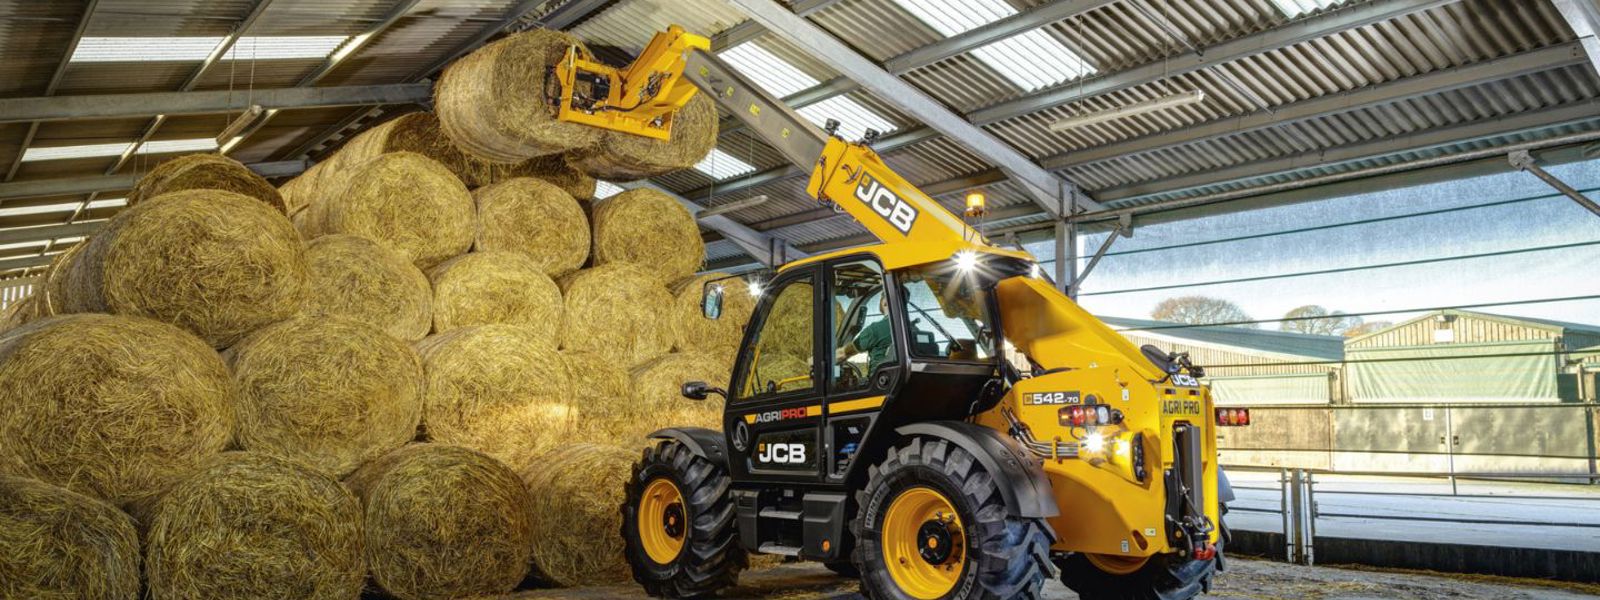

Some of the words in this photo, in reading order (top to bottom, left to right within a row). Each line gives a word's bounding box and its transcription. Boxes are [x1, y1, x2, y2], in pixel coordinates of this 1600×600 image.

[856, 180, 916, 232] JCB
[1173, 374, 1199, 386] JCB
[1163, 400, 1182, 414] AGRI
[1183, 400, 1200, 415] PRO
[759, 443, 806, 463] JCB
